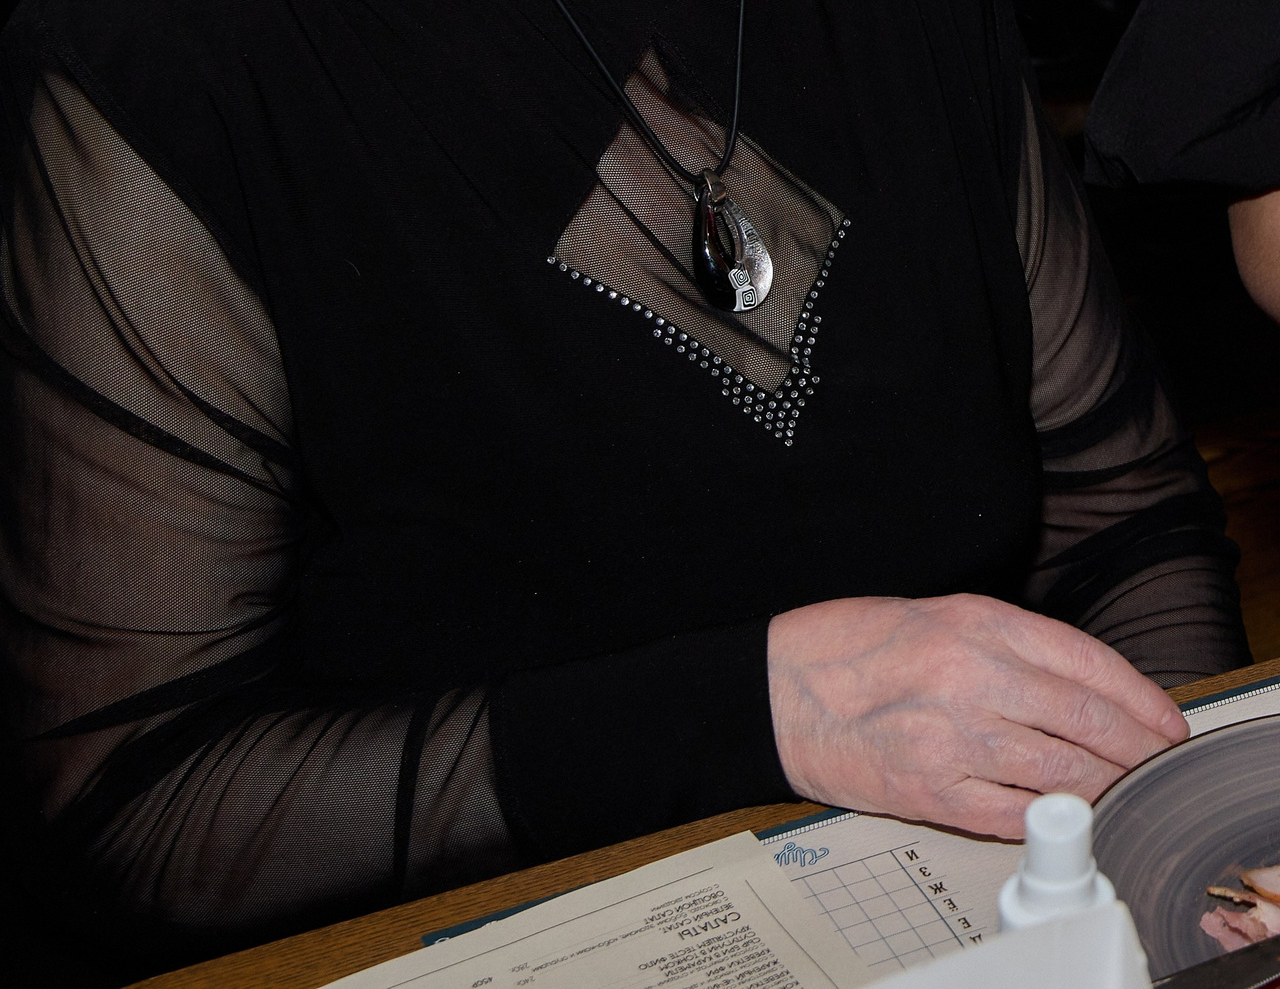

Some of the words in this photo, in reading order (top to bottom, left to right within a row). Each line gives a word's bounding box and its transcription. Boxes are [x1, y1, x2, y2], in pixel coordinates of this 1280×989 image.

[774, 841, 829, 867] Чу
[904, 849, 920, 862] И
[918, 866, 932, 877] З
[928, 881, 948, 895] Ж
[674, 890, 725, 913] ОВОЩНОЙ
[943, 898, 958, 912] Ё
[644, 909, 674, 925] САЛАТ
[692, 902, 735, 922] ЗЕЛЕНЫЙ
[678, 911, 741, 941] САЛАТЫ
[957, 916, 972, 929] Е
[707, 931, 756, 953] СУЛУГУНИ
[742, 937, 761, 948] СЫР
[668, 945, 696, 960] ТЕСТЕ
[721, 944, 741, 956] БРИ
[727, 947, 770, 968] КРЕВЕТКИ
[638, 956, 667, 970] ФИЛО
[659, 953, 700, 971] ТОНКОМ
[664, 956, 713, 977] КАРАМЕЛИ
